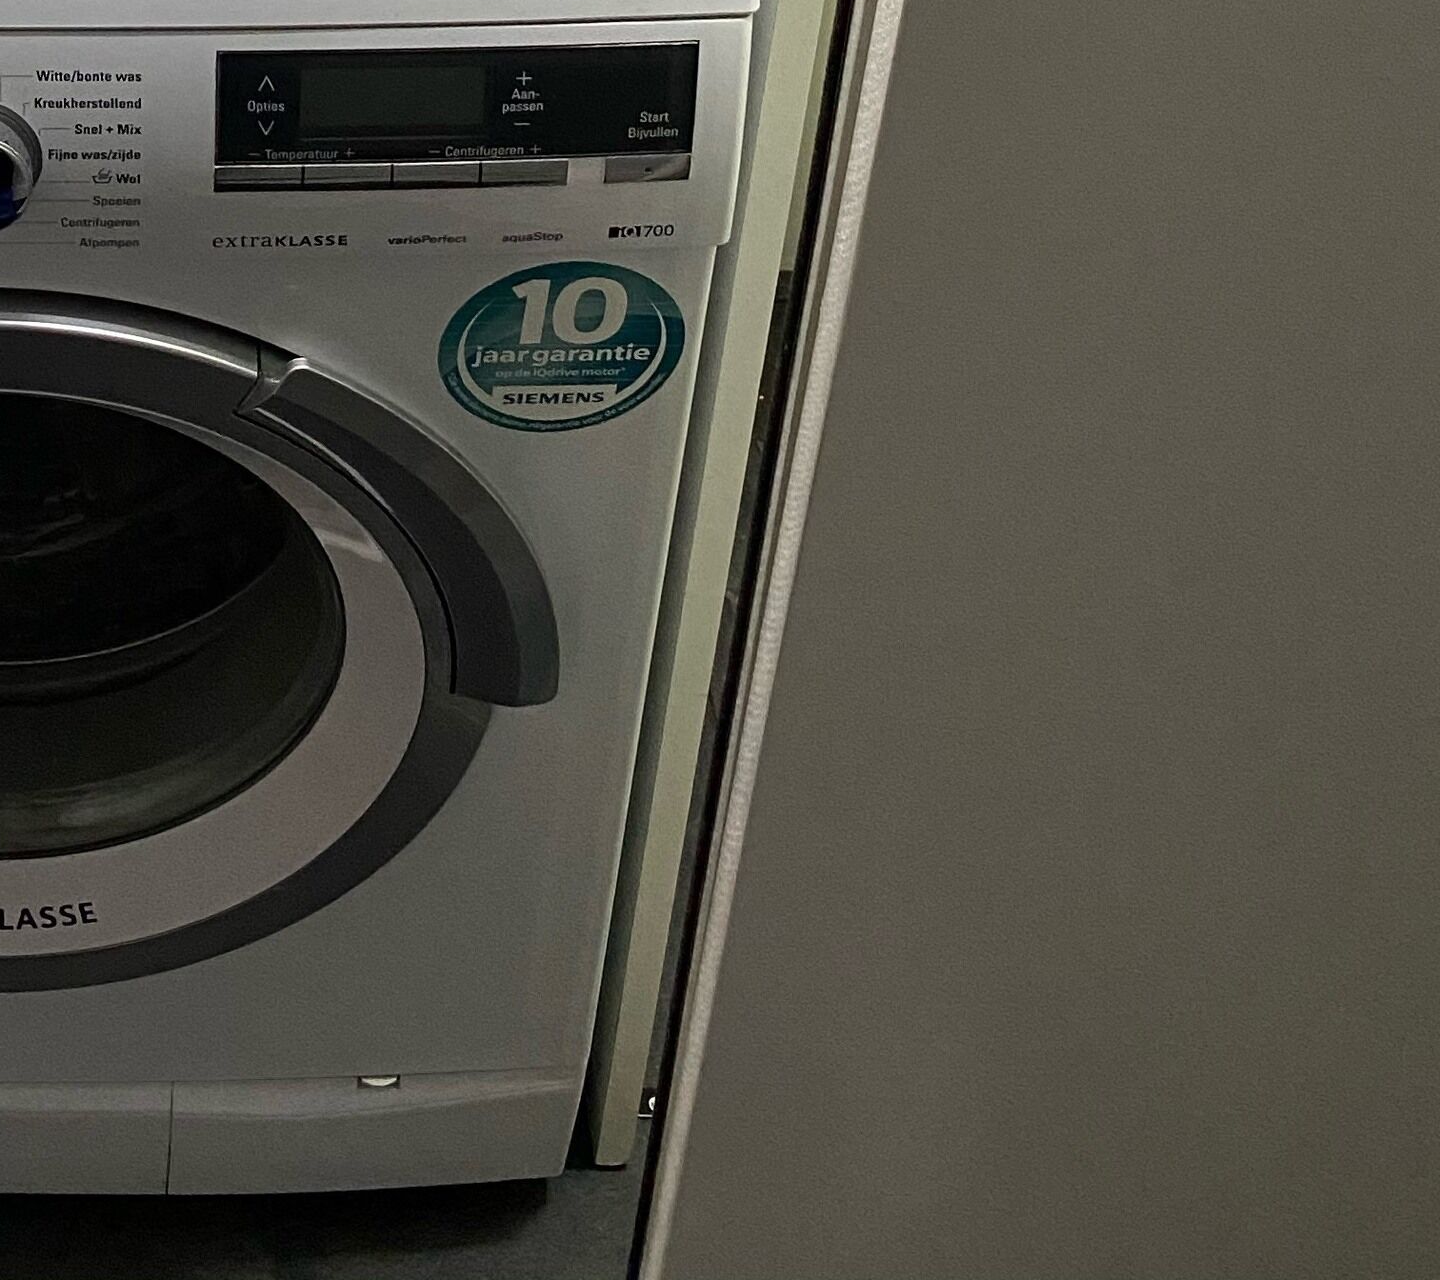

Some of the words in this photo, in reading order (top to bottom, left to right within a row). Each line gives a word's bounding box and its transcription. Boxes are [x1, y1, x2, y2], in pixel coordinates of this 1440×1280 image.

[116, 73, 142, 82] was
[511, 88, 540, 100] Aan-
[34, 98, 142, 109] Kreukherstellend
[247, 100, 285, 113] Opties
[502, 102, 544, 115] passen
[640, 111, 670, 123] Start
[74, 124, 102, 135] Snel
[117, 124, 142, 135] Mix
[628, 126, 679, 139] Bijvullen
[48, 149, 78, 162] Fijne
[81, 149, 141, 162] was/zijde
[265, 148, 338, 161] Temperatuur
[445, 145, 525, 158] Centrifugeren
[116, 174, 141, 184] Wol
[212, 234, 348, 248] extraKLASSE
[512, 276, 628, 344] 10
[471, 344, 529, 367] jaar
[531, 343, 651, 366] garantie
[502, 391, 604, 405] SIEMENS
